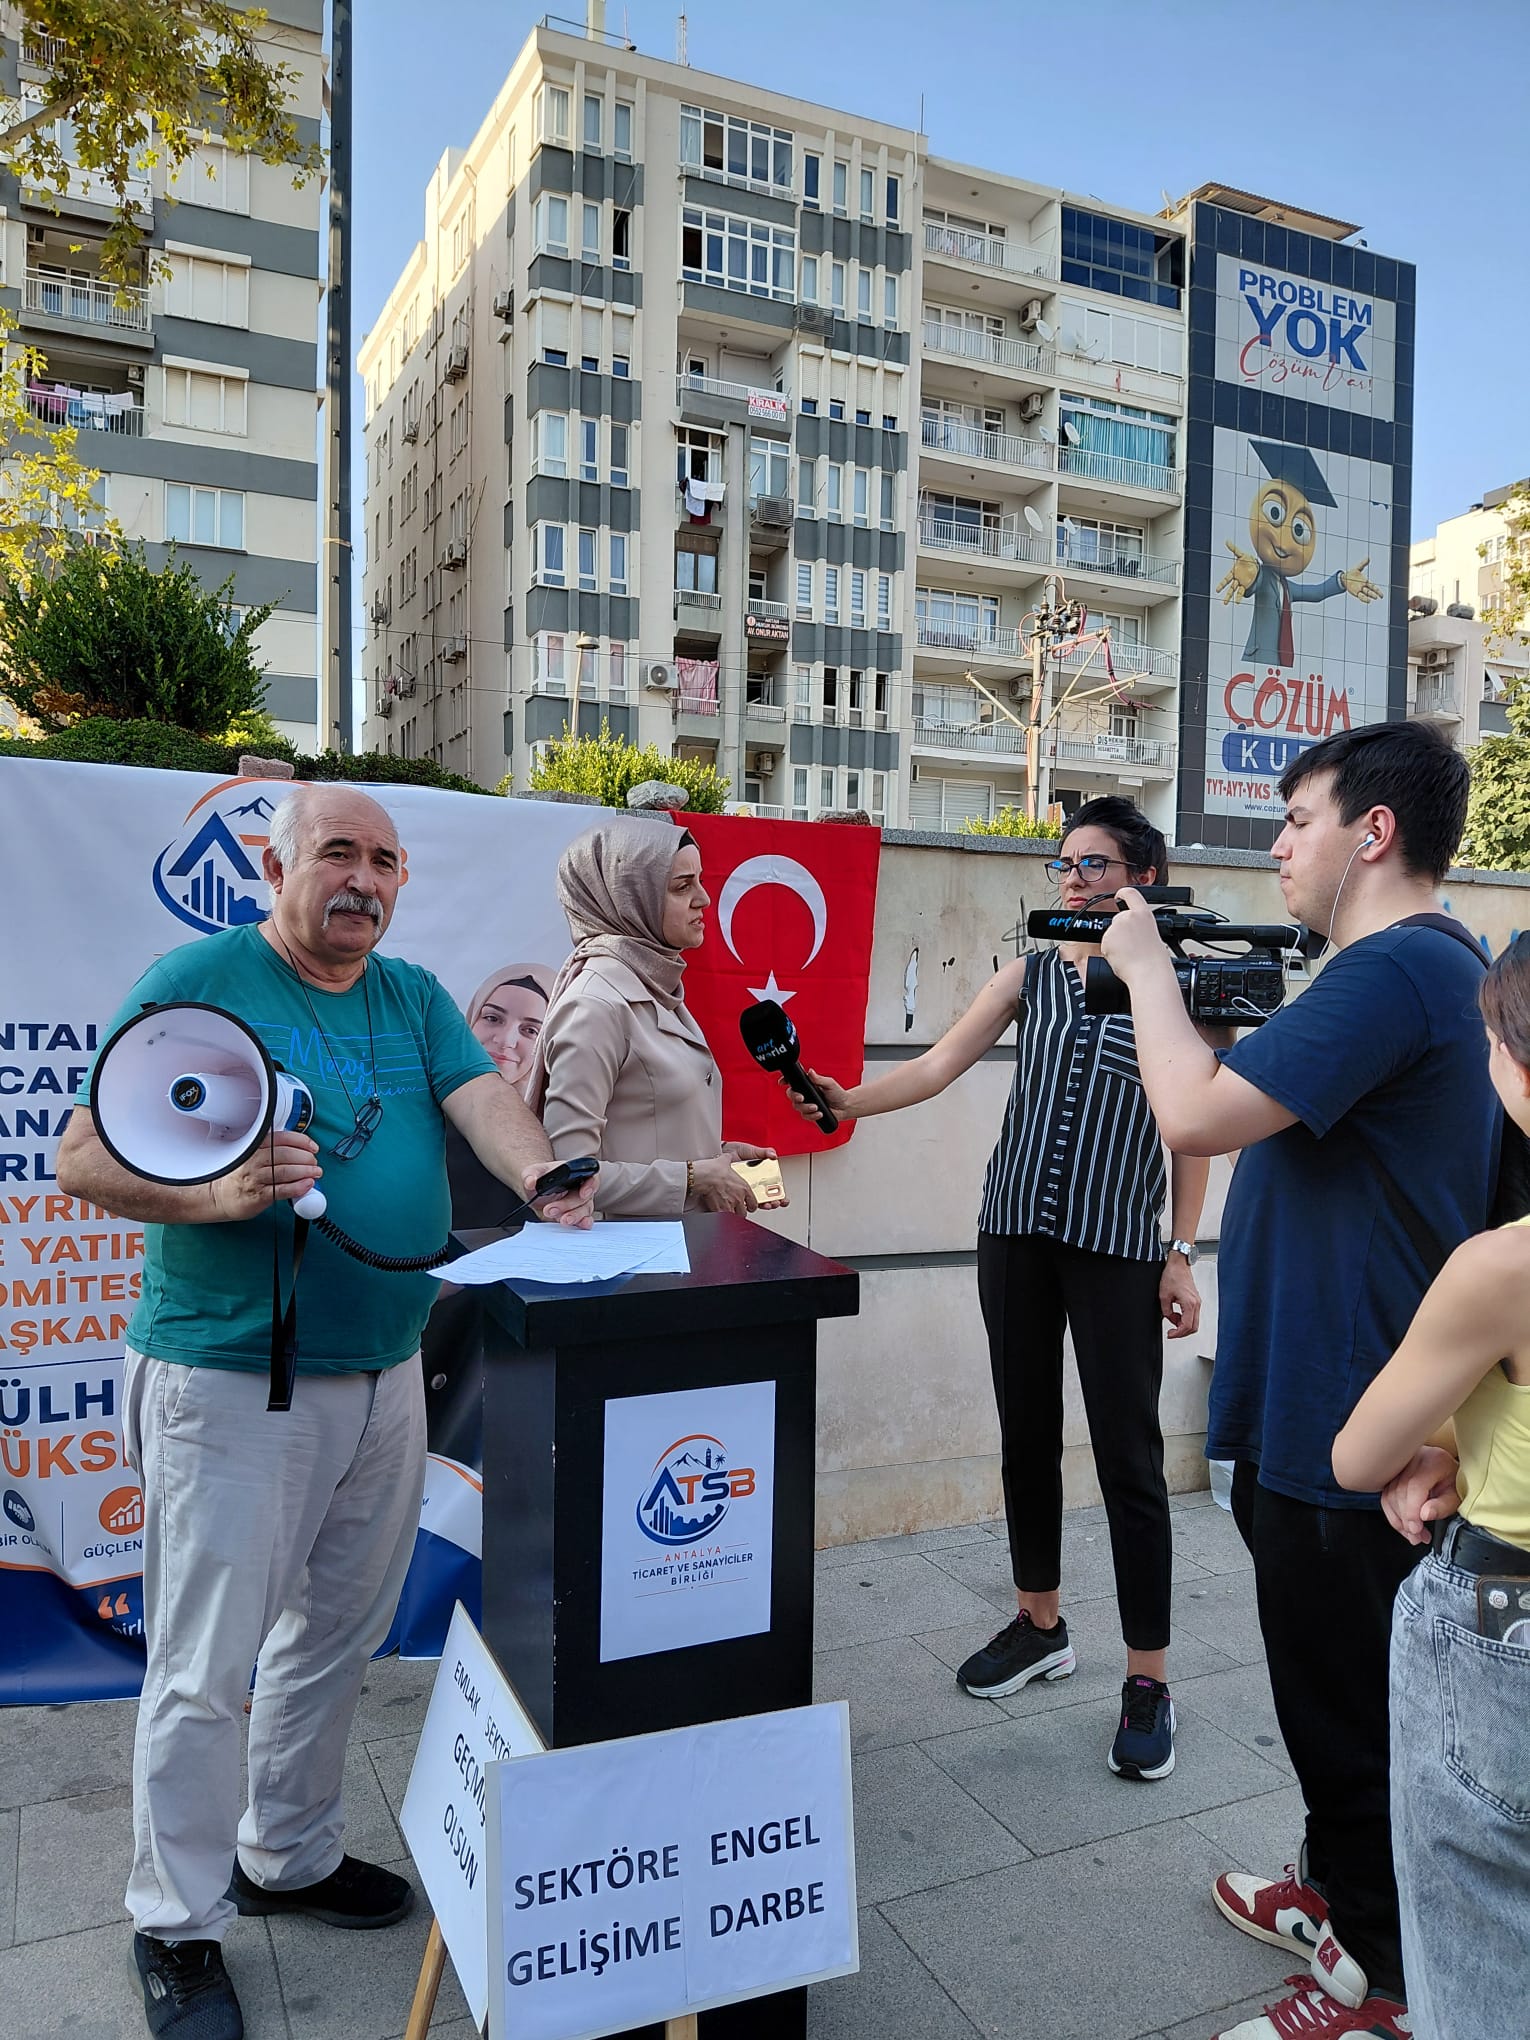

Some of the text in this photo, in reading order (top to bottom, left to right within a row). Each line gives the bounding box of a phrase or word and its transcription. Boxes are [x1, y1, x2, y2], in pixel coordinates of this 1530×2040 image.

[1239, 269, 1372, 325] PROBLEM
[1244, 294, 1368, 371] YOK
[1239, 335, 1320, 383] Çözüm
[1224, 668, 1351, 737] ÇÖZÜM
[756, 1043, 788, 1062] world
[757, 1038, 774, 1053] art
[0, 1312, 128, 1356] ŞKAN
[643, 1466, 756, 1511] ATSB
[83, 1539, 143, 1558] GÜÇLEN
[632, 1552, 753, 1581] TİCARET VE SANAYİCİLER
[665, 1546, 721, 1562] ANTALYA
[671, 1570, 714, 1586] BİRLİĞİ
[454, 1660, 481, 1717] EMLAK
[443, 1803, 478, 1891] OLSUN
[513, 1813, 821, 1910] SEKTÖRE ENGEL
[507, 1881, 826, 1987] GELİŞİME DARBE
